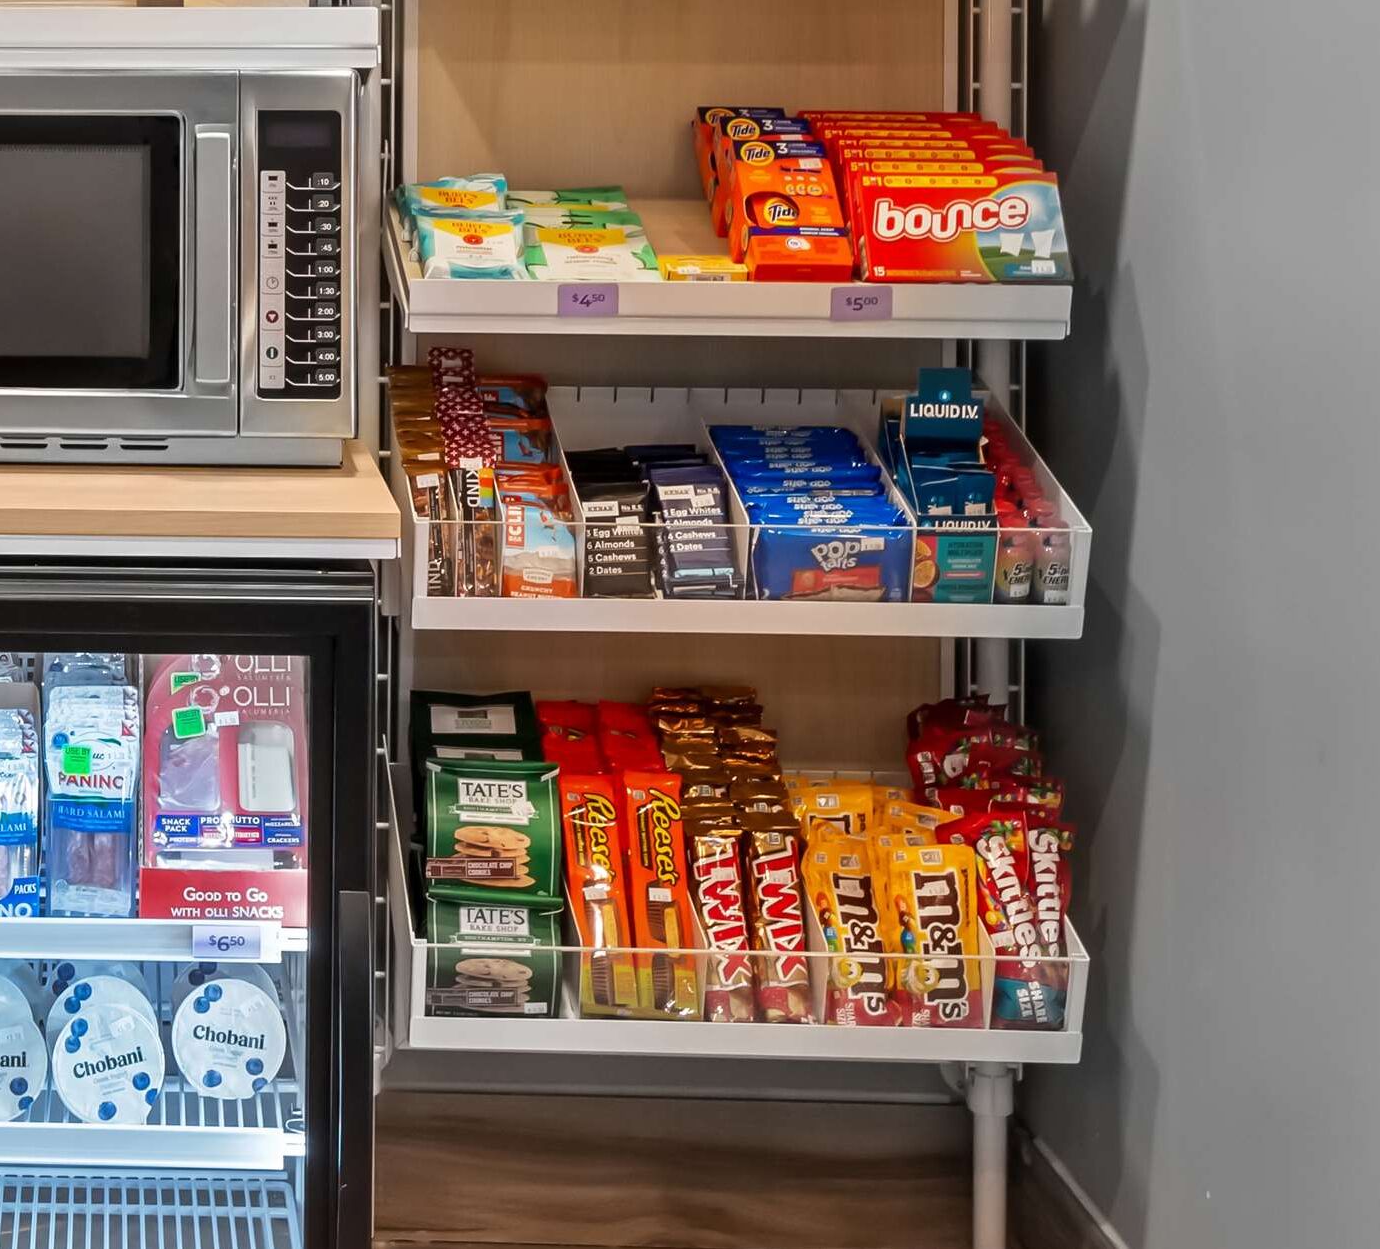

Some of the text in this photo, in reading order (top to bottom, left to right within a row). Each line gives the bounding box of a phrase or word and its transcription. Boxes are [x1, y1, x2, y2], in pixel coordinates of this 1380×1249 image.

[730, 123, 756, 137] Tide
[743, 147, 771, 161] Tide
[777, 143, 788, 154] 3
[876, 199, 1028, 240] bounce
[318, 266, 334, 274] 1:00
[319, 287, 335, 295] 1:30
[318, 308, 334, 316] 2:00
[318, 331, 334, 339] 3:00
[910, 404, 978, 419] LIQUID I.V.
[466, 469, 481, 508] KIND
[670, 508, 687, 517] Egg
[593, 529, 610, 538] Egg
[675, 531, 716, 539] Cashews
[595, 540, 635, 549] Almonds
[676, 543, 703, 551] Dates
[596, 553, 636, 561] Cashews
[233, 686, 290, 707] OLLI
[461, 782, 523, 798] TATE'S
[87, 809, 125, 819] SALAMI
[584, 793, 616, 884] Reese's
[649, 788, 681, 886] Reese's
[14, 884, 37, 894] PACKS
[977, 835, 1042, 968] Skittles
[170, 906, 284, 919] WITH OLLI SNACKS
[466, 909, 525, 925] TATE'S
[694, 835, 752, 985] TWIX
[752, 835, 809, 984] TWIX
[832, 873, 887, 1015] m&m's
[913, 871, 968, 1021] m&m's
[1017, 988, 1035, 1017] SIZE
[1028, 981, 1048, 1023] SHARE
[192, 1024, 264, 1050] Chobani
[73, 1046, 144, 1079] Chobani
